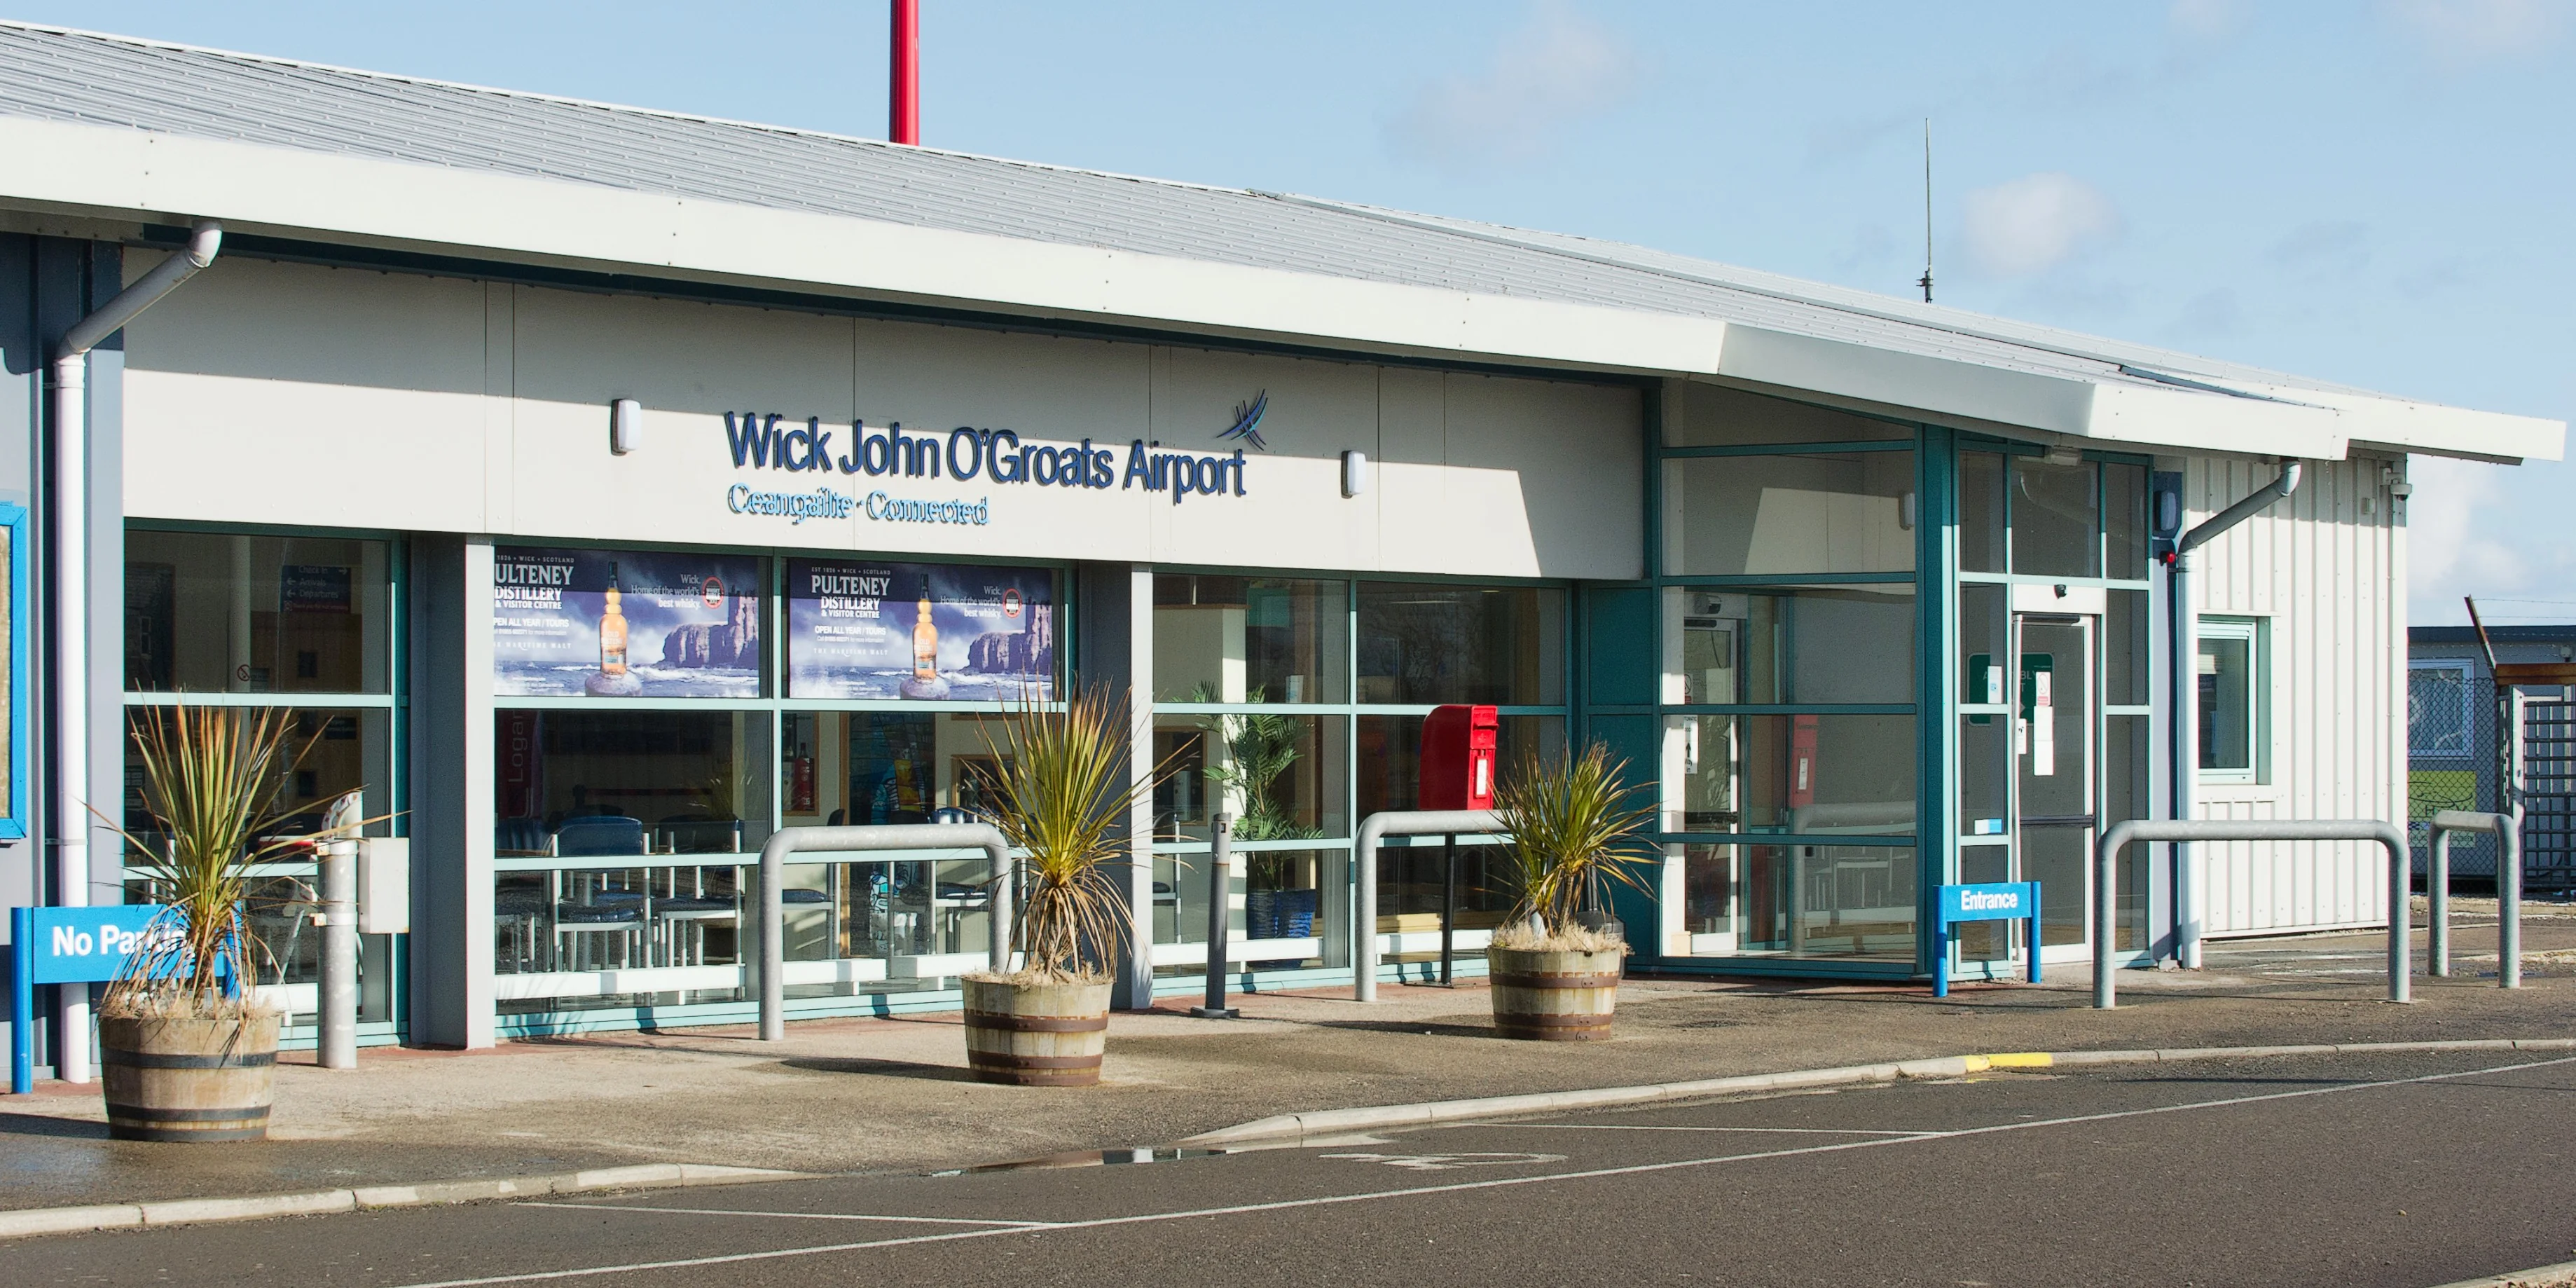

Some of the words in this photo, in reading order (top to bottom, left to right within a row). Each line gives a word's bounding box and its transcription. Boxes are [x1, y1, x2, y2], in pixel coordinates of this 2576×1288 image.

[726, 411, 832, 471] Wick
[840, 419, 940, 477] John
[949, 427, 1114, 488] O'Groats
[1124, 439, 1247, 504] Airport
[867, 491, 990, 525] Connected
[299, 577, 326, 587] Arrivals
[811, 575, 890, 596] PULTENEY
[299, 589, 339, 599] Departures
[494, 586, 563, 601] DISTILLERY
[631, 585, 653, 594] Home
[653, 586, 662, 594] of
[662, 586, 673, 595] the
[674, 587, 699, 596] world's
[504, 600, 532, 609] VISITOR
[534, 601, 563, 610] CENTRE
[658, 598, 673, 608] best
[820, 596, 881, 610] DISTILLERY
[940, 595, 960, 605] Home
[960, 596, 967, 605] of
[967, 596, 977, 605] the
[964, 608, 977, 617] best
[508, 617, 522, 626] ALL
[522, 618, 540, 627] YEAR
[546, 619, 570, 628] TOURS
[814, 625, 832, 634] OPEN
[833, 626, 844, 634] ALL
[845, 626, 862, 635] YEAR
[1961, 889, 2018, 910] Entrance
[52, 925, 93, 957] No
